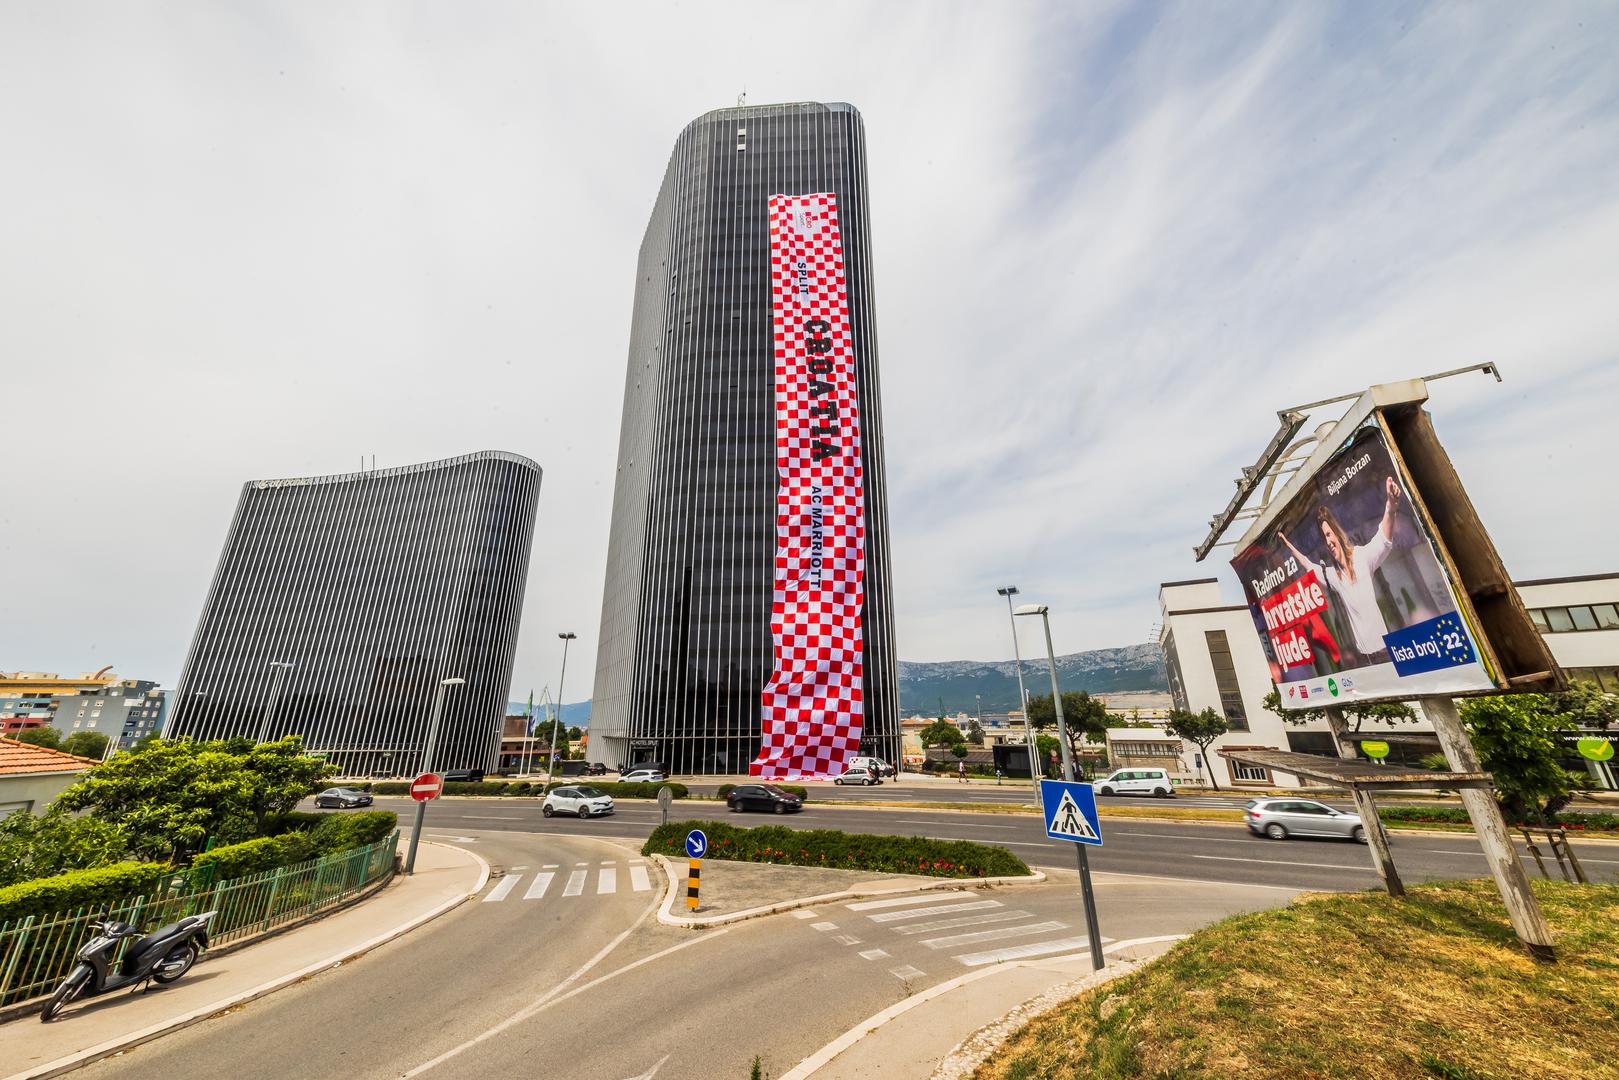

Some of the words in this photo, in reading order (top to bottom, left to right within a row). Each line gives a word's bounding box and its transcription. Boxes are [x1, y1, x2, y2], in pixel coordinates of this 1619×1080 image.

[797, 262, 809, 295] SPLIT
[805, 319, 842, 462] CROATIA
[812, 486, 822, 503] AC
[1327, 474, 1348, 496] Biljana
[1345, 453, 1371, 480] Borzan
[811, 508, 822, 588] MARRIOTT
[1252, 566, 1286, 599] Radimo
[1284, 556, 1298, 577] za
[1261, 581, 1325, 631] hrvatske
[1272, 630, 1311, 673] ljude
[1391, 645, 1415, 663] lista
[1412, 634, 1442, 658] broj
[1443, 632, 1463, 650] 22
